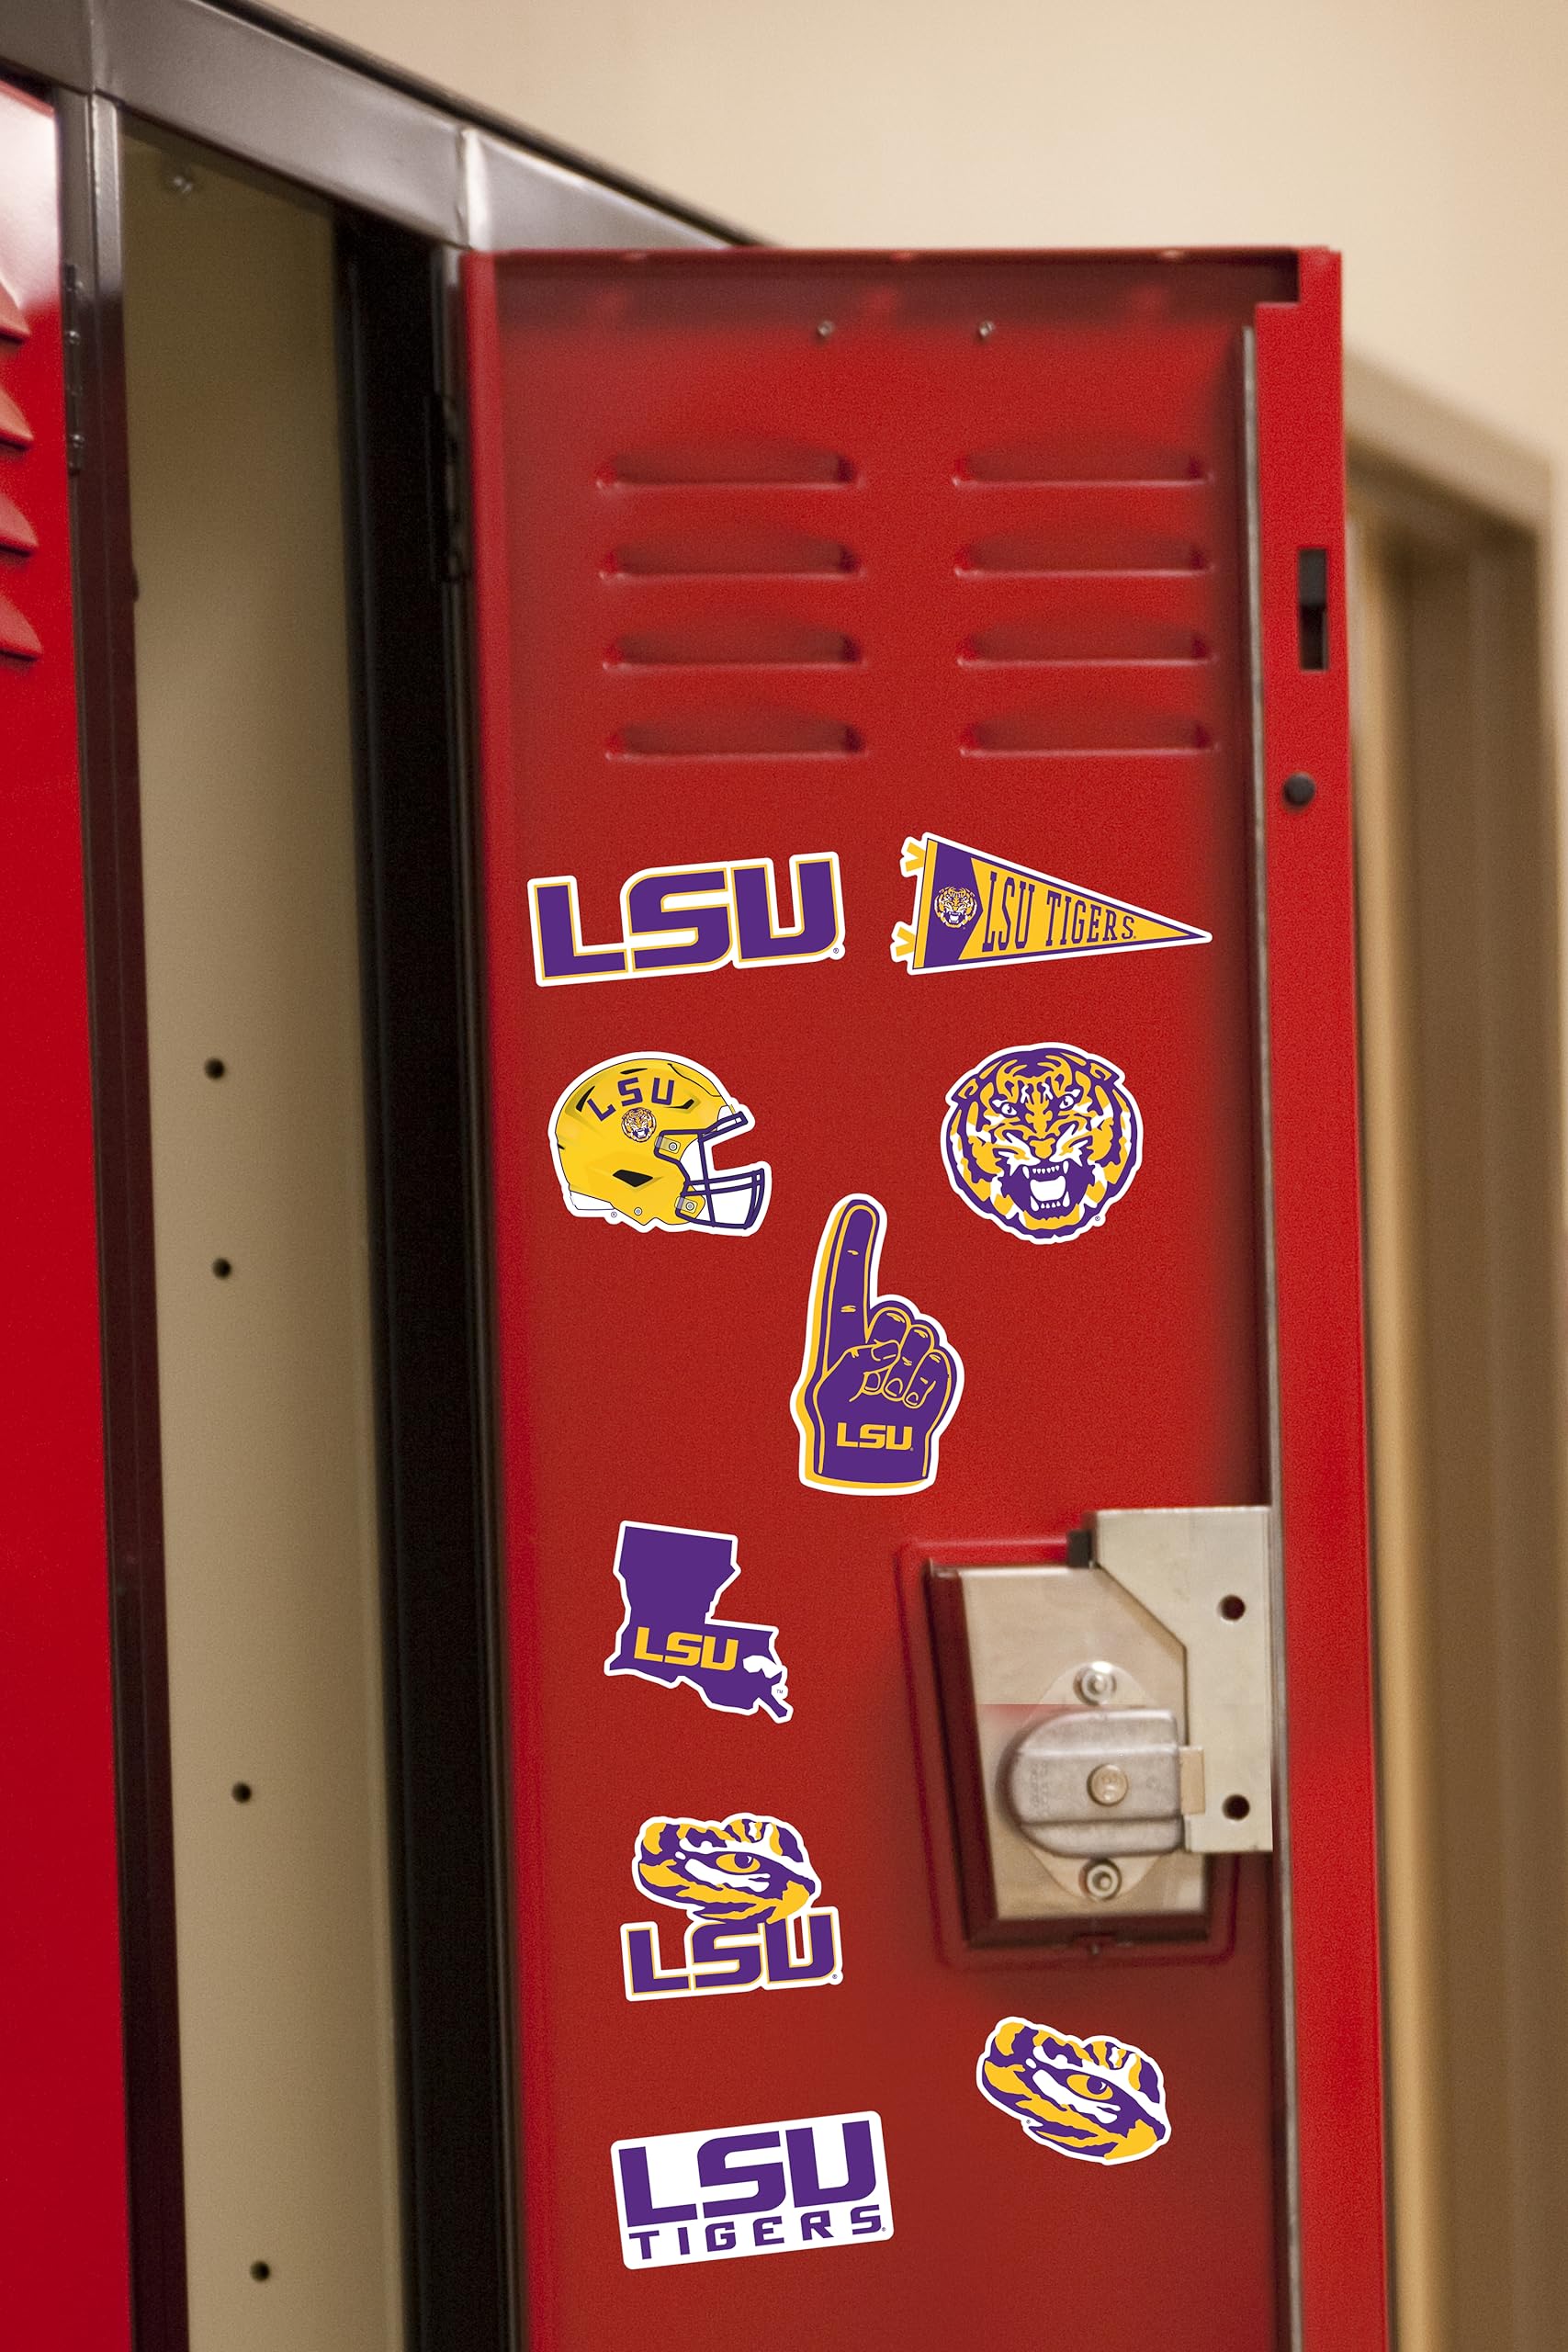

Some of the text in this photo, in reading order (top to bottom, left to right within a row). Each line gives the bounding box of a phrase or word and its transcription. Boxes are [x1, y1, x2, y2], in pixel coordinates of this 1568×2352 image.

[534, 858, 838, 979] LSU
[982, 871, 1134, 952] LSU TIGERS
[587, 1077, 675, 1121] LSU
[836, 1422, 913, 1451] LSU
[634, 1626, 739, 1671] LSU
[626, 1913, 835, 1995] LSU
[618, 2120, 876, 2227] LSU
[628, 2205, 882, 2259] TIGERS
